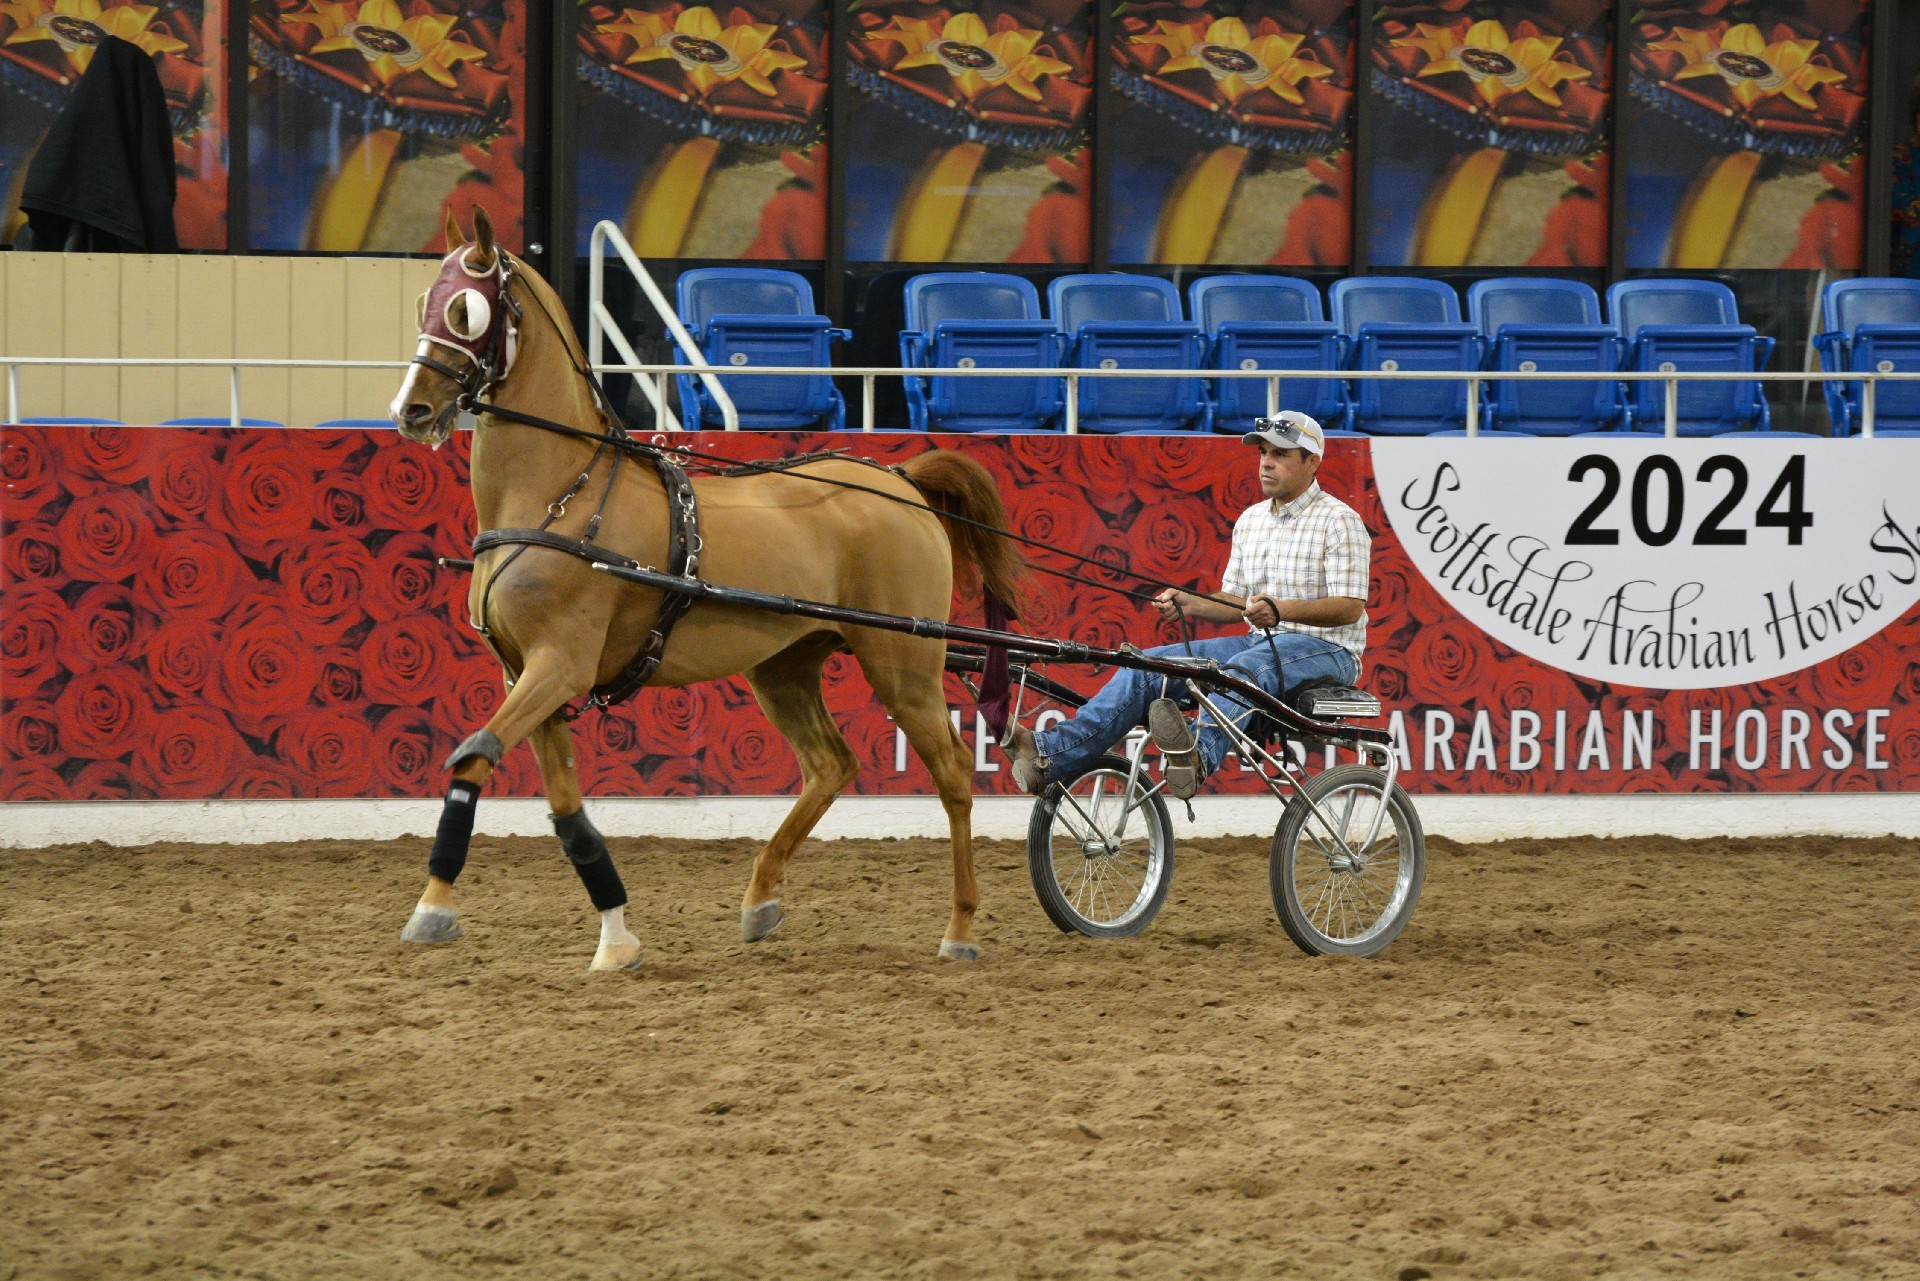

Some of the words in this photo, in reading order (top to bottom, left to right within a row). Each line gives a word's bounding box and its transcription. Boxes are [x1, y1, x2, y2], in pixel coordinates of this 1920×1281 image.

[1563, 453, 1815, 547] 2024
[1400, 461, 1594, 644] Scottsdale
[1576, 580, 1757, 671] Arabian
[1764, 579, 1885, 661] Horse
[1689, 708, 1892, 771] HORSE
